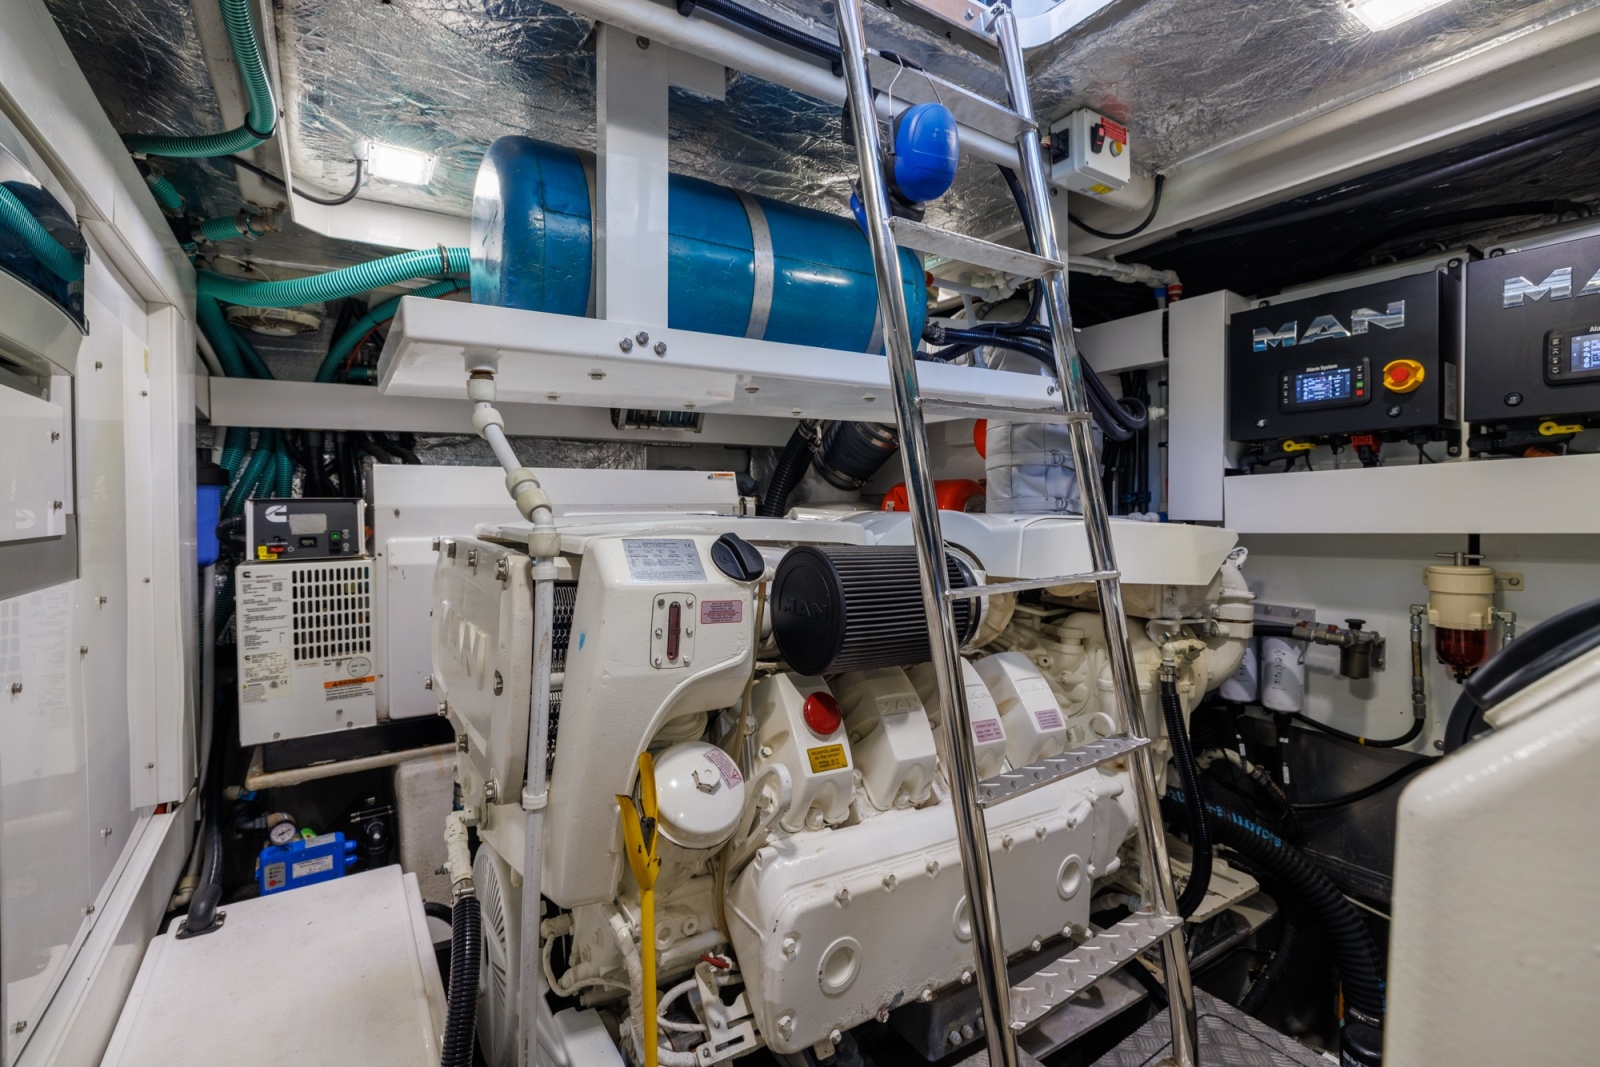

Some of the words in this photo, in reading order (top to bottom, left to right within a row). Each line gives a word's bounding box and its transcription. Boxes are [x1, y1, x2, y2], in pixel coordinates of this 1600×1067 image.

[1253, 300, 1405, 352] MAN
[779, 598, 829, 622] MAN
[338, 677, 366, 686] WARNING
[1231, 812, 1282, 848] LLOYD'S
